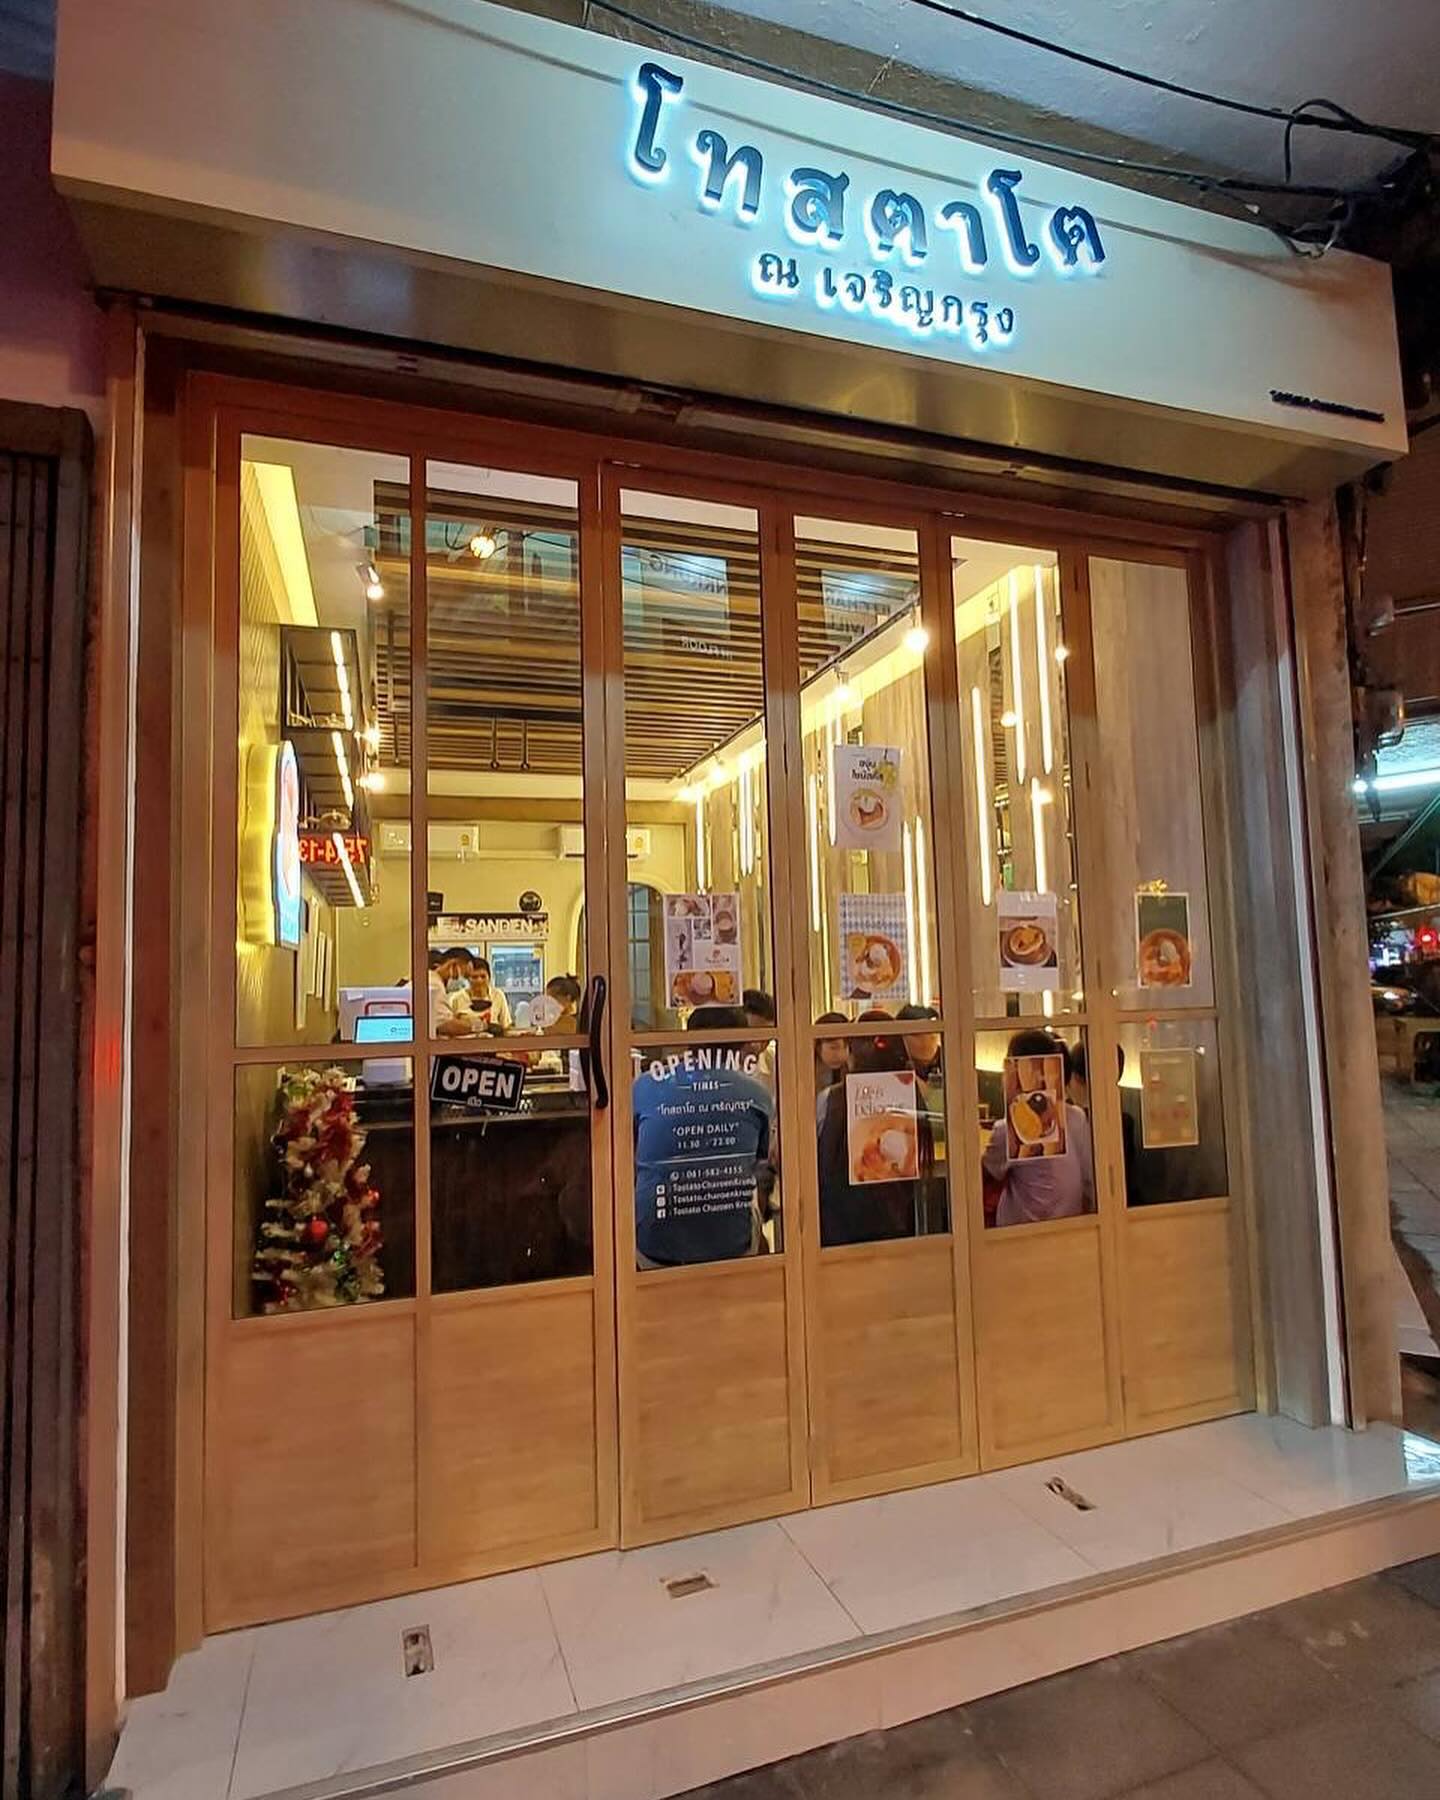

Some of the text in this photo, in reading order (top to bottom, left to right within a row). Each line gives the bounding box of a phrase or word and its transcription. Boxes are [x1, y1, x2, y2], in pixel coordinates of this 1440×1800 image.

[635, 62, 1106, 266] โทสตาโต
[759, 253, 1014, 344] ณ เจริญกรุง
[465, 917, 533, 935] SANDEN
[650, 1048, 758, 1081] OPENING
[442, 1065, 515, 1099] OPEN
